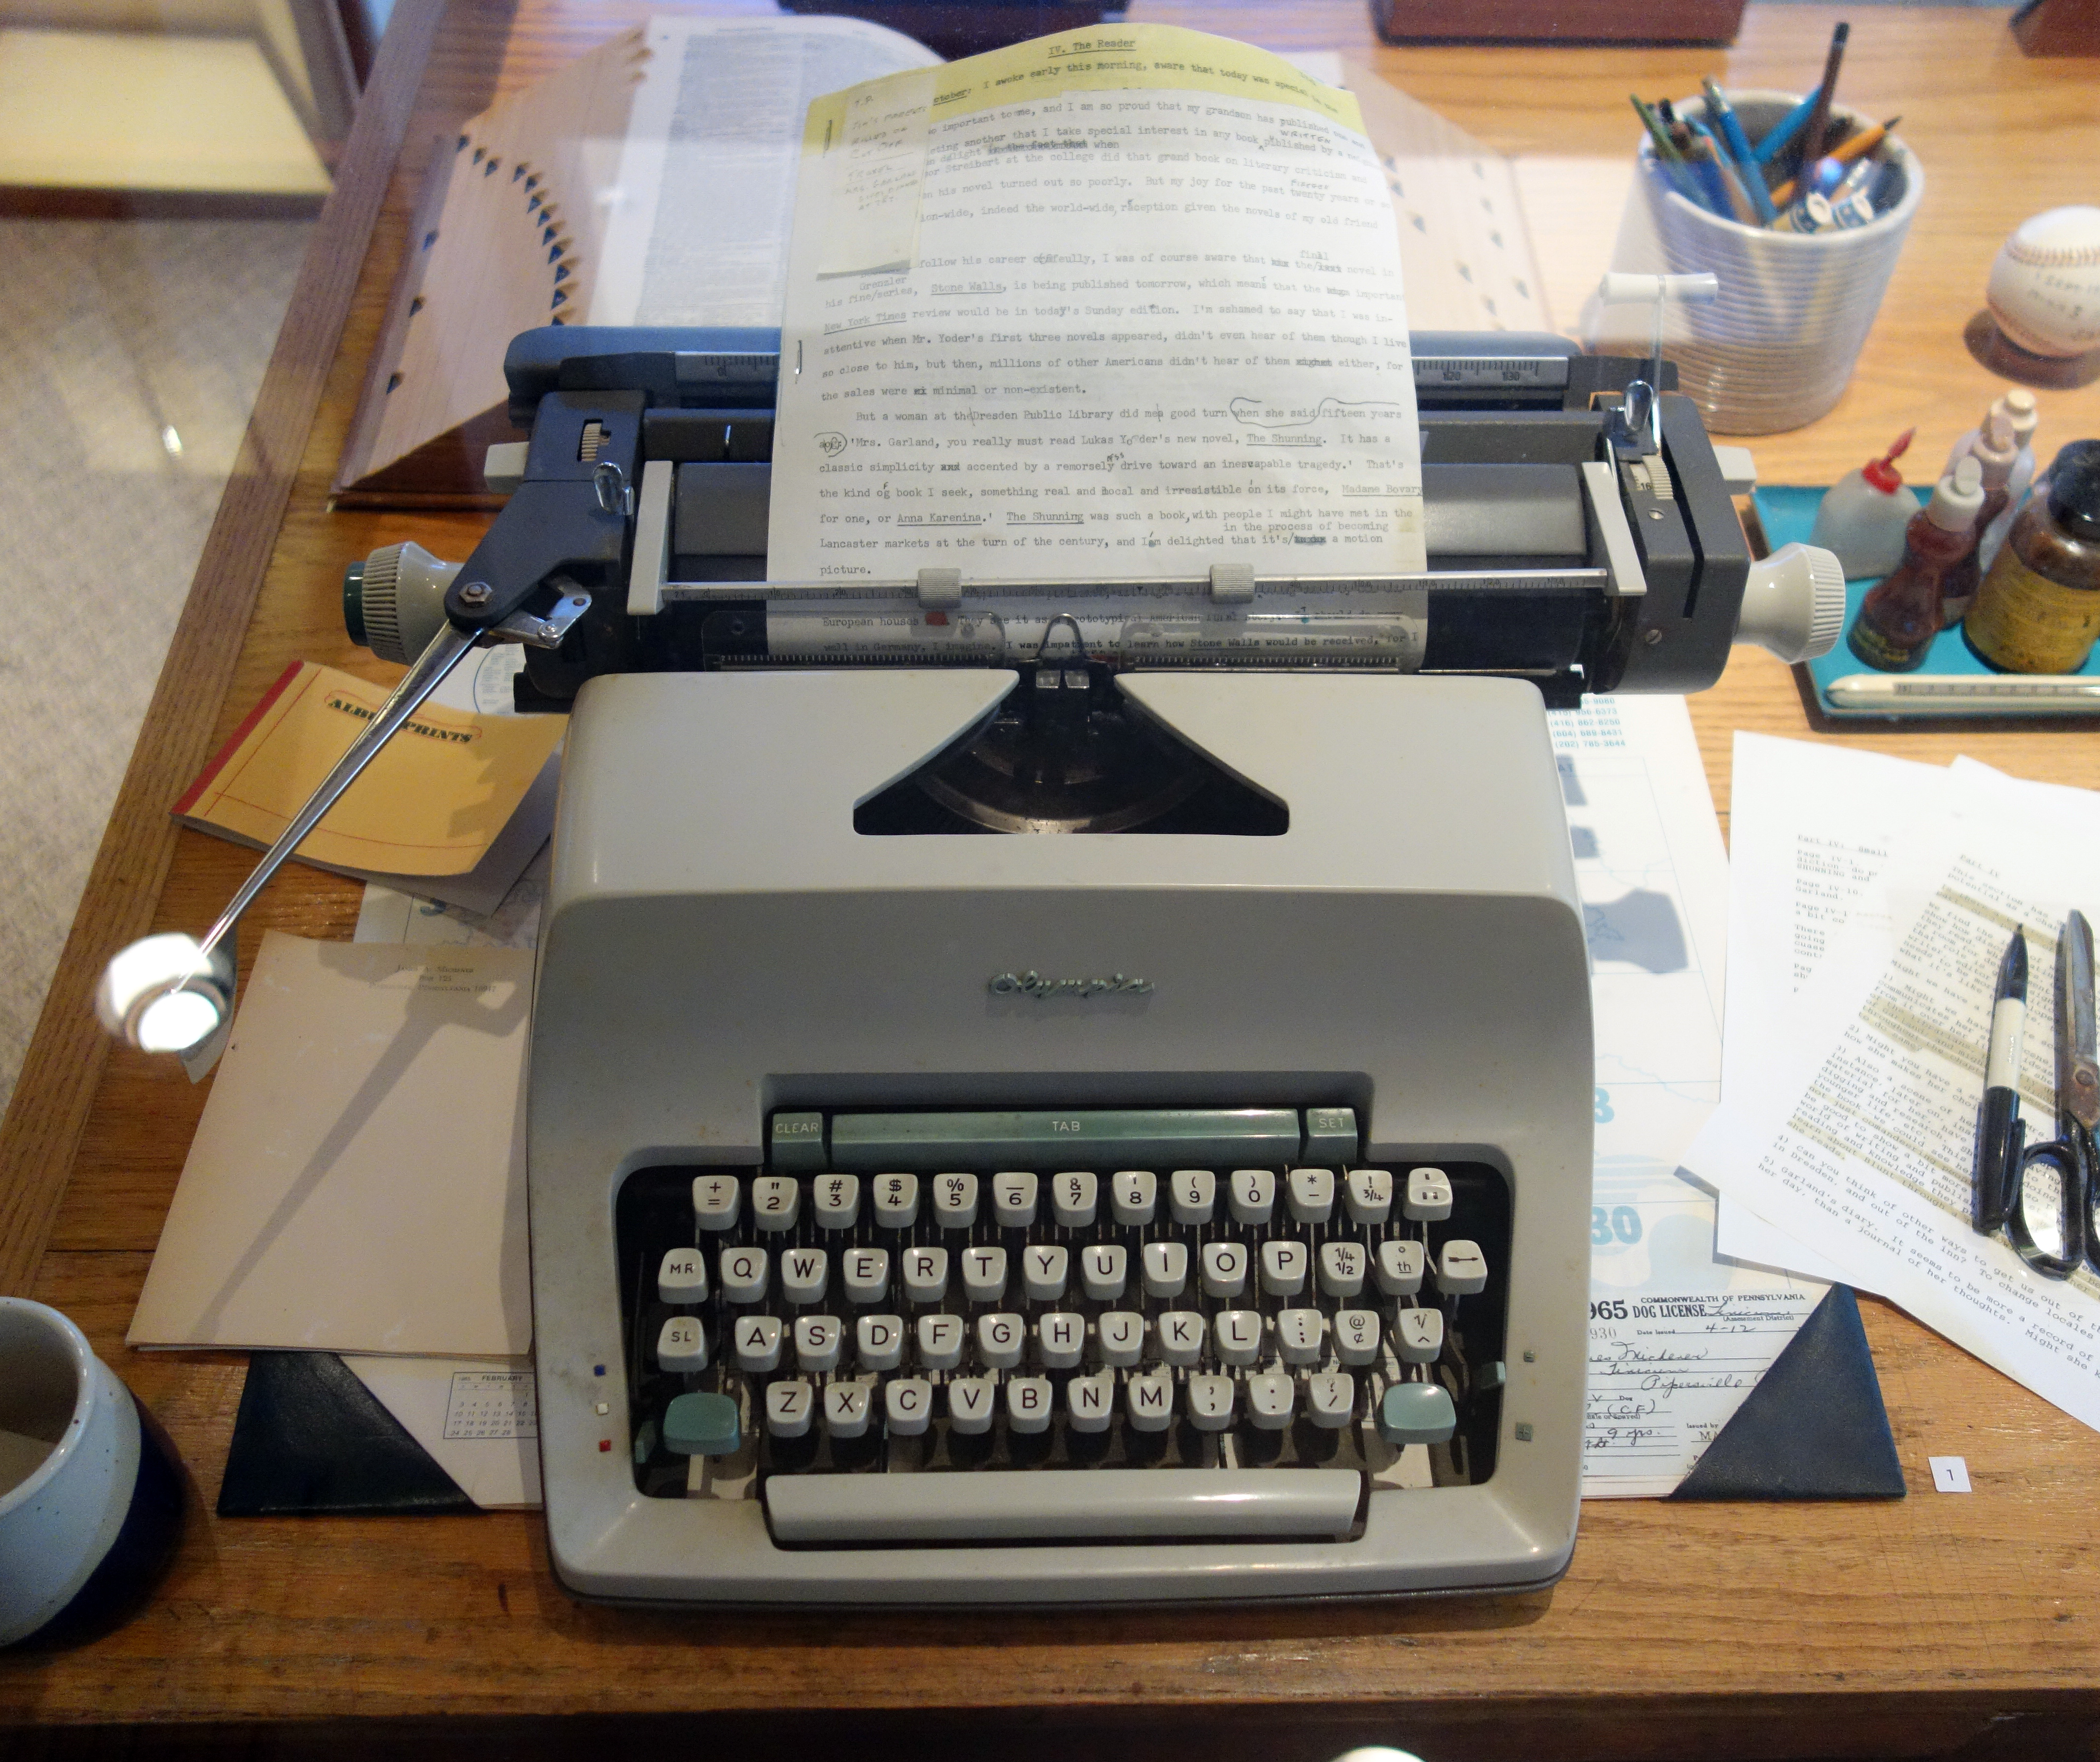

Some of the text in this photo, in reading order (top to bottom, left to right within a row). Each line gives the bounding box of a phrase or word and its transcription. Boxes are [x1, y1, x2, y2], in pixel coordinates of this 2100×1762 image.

[1049, 39, 1135, 56] IV. The Reader
[983, 60, 1270, 89] I awoke early this morning, aware that today was
[931, 281, 1006, 294] Stone Walls,
[824, 311, 906, 332] New York Times
[824, 331, 1105, 355] attentive when Mr. Yoder's first three novels
[821, 392, 838, 401] the
[844, 387, 875, 398] sales
[933, 385, 978, 395] minimal
[1003, 383, 1086, 394] non-existent.
[856, 412, 876, 421] But
[973, 410, 1018, 420] Dresden
[1024, 409, 1062, 420] Public
[1068, 409, 1114, 421] Library
[888, 437, 940, 449] Garland,
[947, 439, 967, 449] you
[973, 436, 1012, 448] really
[1017, 436, 1043, 445] must
[1050, 435, 1075, 445] read
[898, 513, 923, 522] Anna
[820, 537, 1109, 549] Lancaster markets turn century,
[820, 565, 871, 577] picture.
[1228, 638, 1260, 647] Walls
[1266, 637, 1297, 646] would
[1304, 636, 1316, 645] be
[1323, 635, 1378, 646] received,
[1794, 932, 1825, 944] going
[1795, 924, 1825, 935] There
[775, 1117, 1346, 1134] CLEAR TAB SET
[1791, 1152, 1891, 1217] Dresden, and out
[766, 1196, 780, 1210] 2
[829, 1194, 842, 1207] 3
[887, 1194, 902, 1207] 4
[950, 1193, 961, 1207] 5
[1009, 1192, 1022, 1206] 6
[1071, 1192, 1081, 1206] 7
[1129, 1191, 1142, 1204] 8
[1189, 1190, 1200, 1204] 9
[670, 1263, 694, 1274] MR
[733, 1258, 752, 1279] Q
[793, 1258, 815, 1278] W
[856, 1258, 874, 1278] E
[917, 1257, 934, 1277] R
[975, 1257, 993, 1277] T
[1037, 1255, 1054, 1275] Y
[1097, 1255, 1113, 1275] U
[1163, 1253, 1168, 1272] I
[1216, 1253, 1236, 1272] O
[1277, 1251, 1294, 1270] P
[1397, 1261, 1411, 1272] th
[1758, 1162, 1777, 1177] her
[1782, 1178, 1806, 1197] day,
[1814, 1197, 1839, 1217] than
[1857, 1227, 1902, 1256] journal
[1927, 1269, 1947, 1284] her
[1953, 1285, 2011, 1325] thoughts.
[2025, 1329, 2060, 1354] Might
[2066, 1355, 2088, 1370] she
[1763, 1156, 1775, 1166] 5)
[1781, 1167, 1837, 1205] Garland's
[1841, 1204, 1878, 1231] diary.
[1891, 1235, 1904, 1247] It
[1910, 1248, 1943, 1270] seems
[1948, 1271, 1961, 1283] to
[1967, 1280, 1980, 1293] be
[1986, 1295, 2014, 1315] more
[2032, 1323, 2074, 1350] record
[2078, 1351, 2094, 1362] of
[1632, 1305, 1656, 1318] DOG
[1659, 1304, 1706, 1318] LICENSE
[671, 1321, 1248, 1347] SL A S D F G H J K L
[779, 1386, 1163, 1413] Z X C V B N M
[1946, 1469, 1953, 1481] 1
